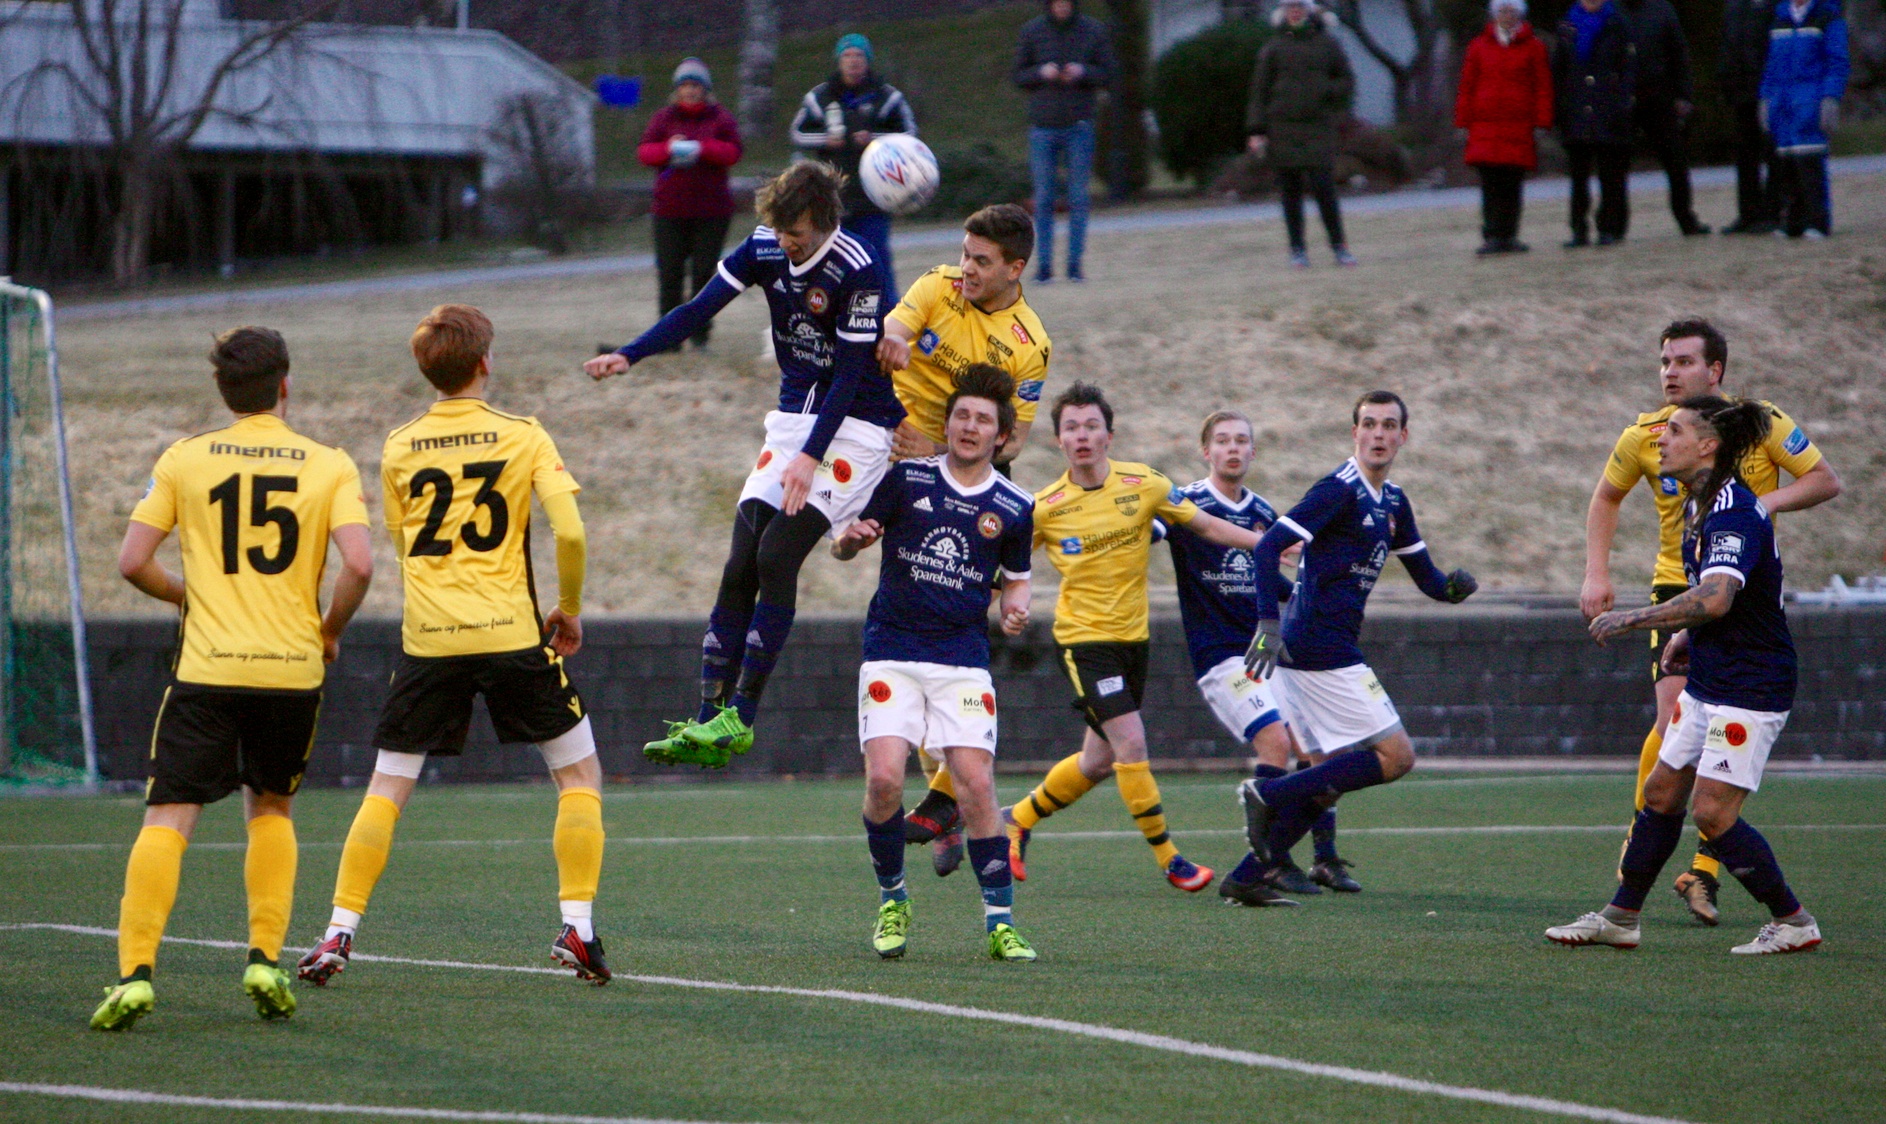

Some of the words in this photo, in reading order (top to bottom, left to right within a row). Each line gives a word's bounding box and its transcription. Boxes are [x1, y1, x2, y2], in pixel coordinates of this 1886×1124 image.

[847, 313, 878, 329] ÅKRA
[209, 440, 306, 461] imenco
[411, 431, 498, 452] imenco
[408, 458, 510, 557] 23
[1048, 505, 1083, 518] macron
[208, 472, 300, 575] 15
[920, 526, 970, 560] KARMØYBANKEN
[897, 546, 945, 569] Skudenes
[945, 559, 957, 573] &
[956, 563, 984, 583] Aakra
[1708, 552, 1739, 565] ÅKRA
[910, 565, 965, 591] Sparebank
[1202, 570, 1243, 580] Skudenes
[419, 622, 442, 633] Sunn
[444, 625, 455, 634] og
[208, 647, 234, 658] Sunn
[236, 652, 248, 662] og
[1248, 694, 1264, 710] 16
